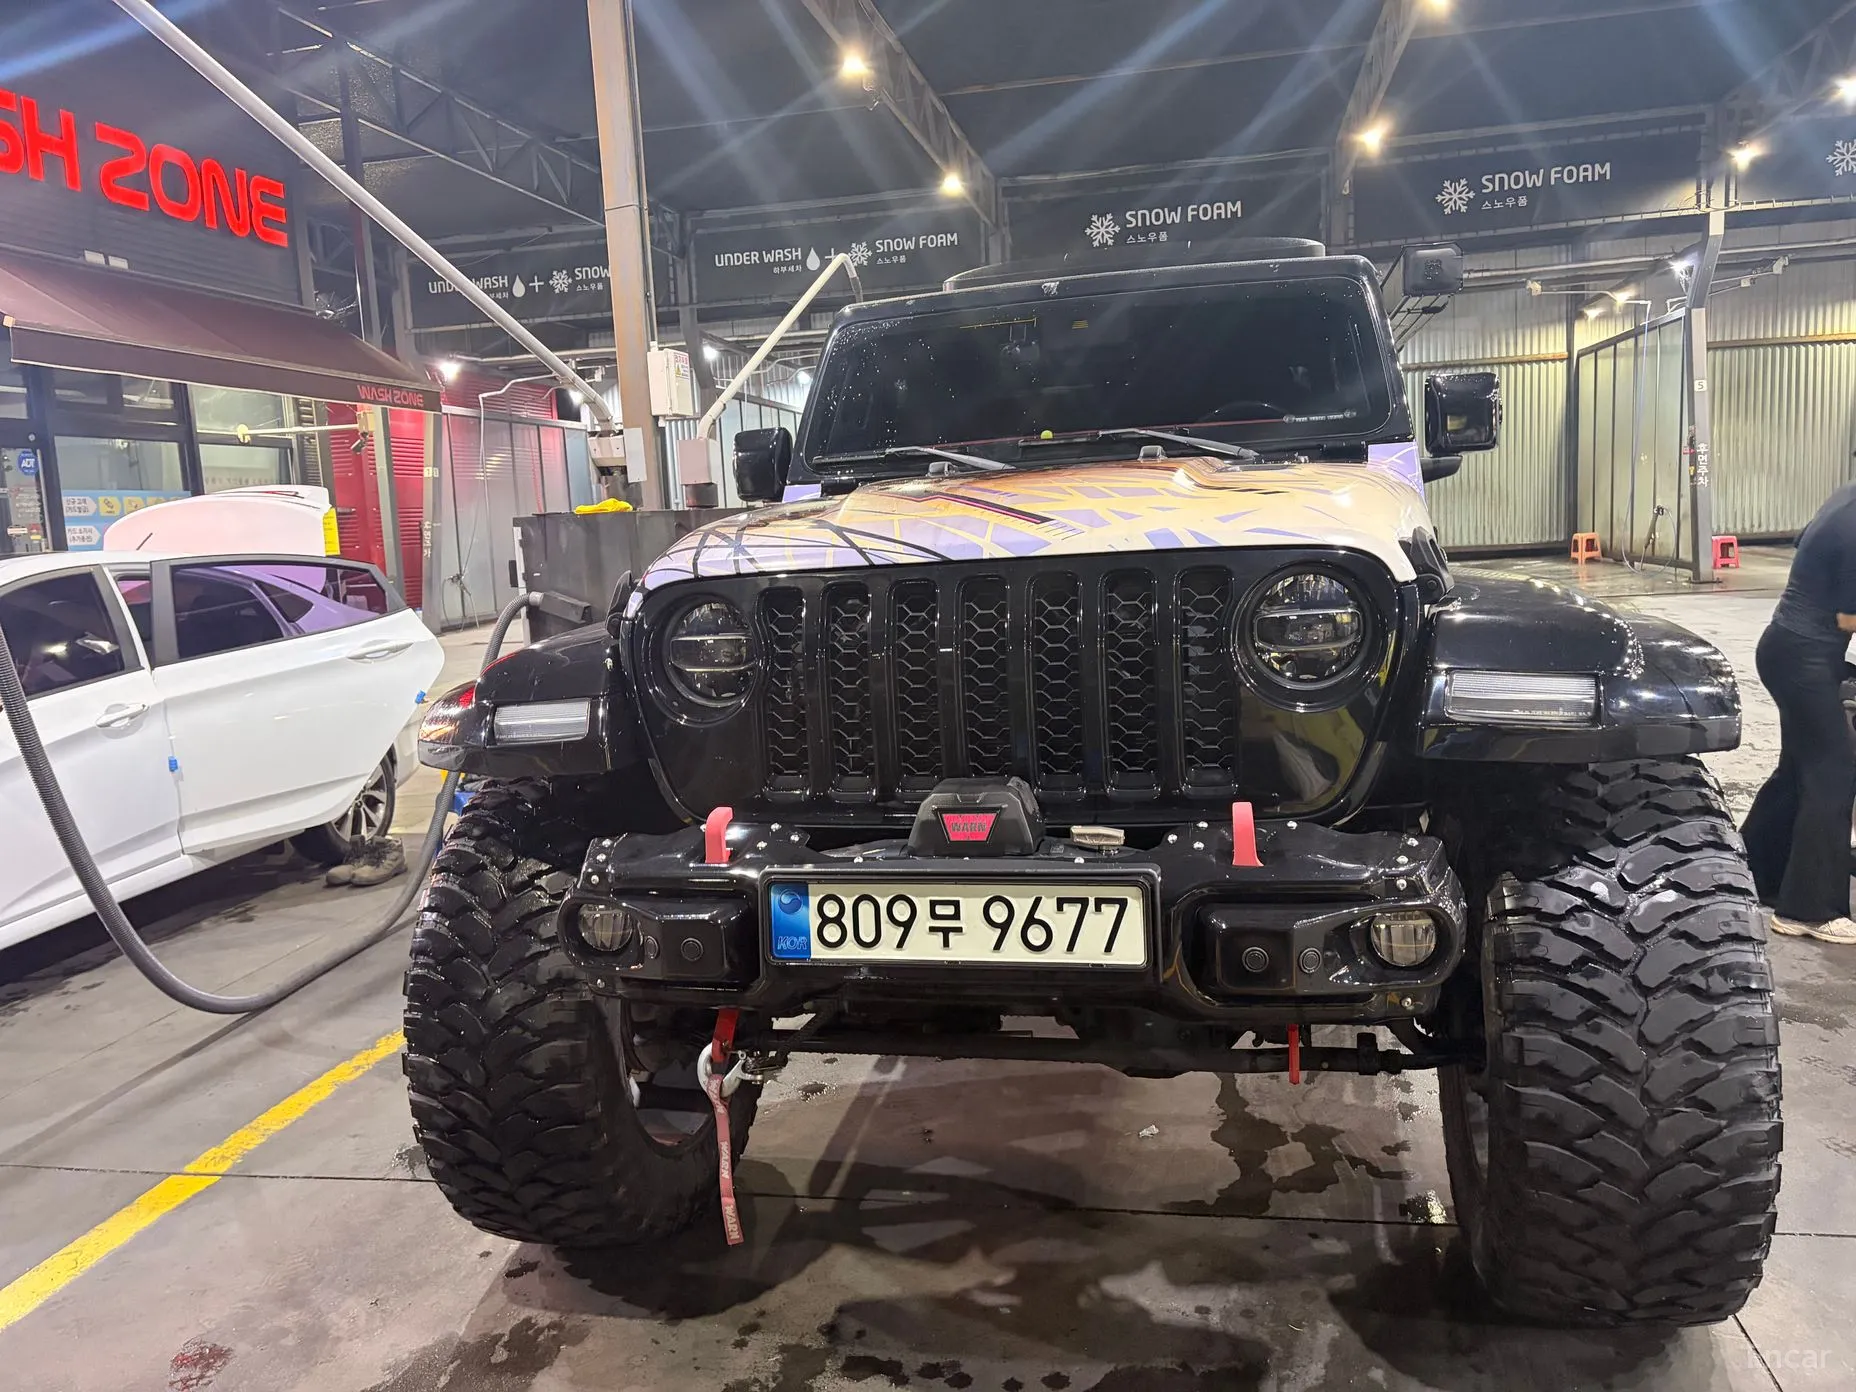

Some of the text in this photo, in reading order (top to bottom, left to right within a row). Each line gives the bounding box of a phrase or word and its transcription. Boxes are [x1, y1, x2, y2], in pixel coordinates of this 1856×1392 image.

[95, 121, 289, 248] ZONE
[1481, 162, 1611, 193] SNOW FOAM
[1481, 195, 1528, 210] 스노우폼
[1125, 200, 1242, 228] SNOW FOAM
[1126, 231, 1168, 244] 스노우폼
[715, 232, 958, 267] UNDER WASH SNOW FOAM
[876, 254, 906, 265] 스노우폼
[428, 280, 459, 294] UND
[576, 282, 604, 291] 스노우폼
[1697, 381, 1704, 390] 5
[357, 384, 424, 407] WASH ZONE
[21, 458, 36, 469] ADT
[1697, 442, 1709, 488] 후면주차
[951, 822, 987, 833] WARN
[816, 893, 1129, 954] 809무 9677
[777, 936, 808, 950] KOR
[720, 1141, 730, 1179] WARN
[725, 1204, 740, 1240] WARN
